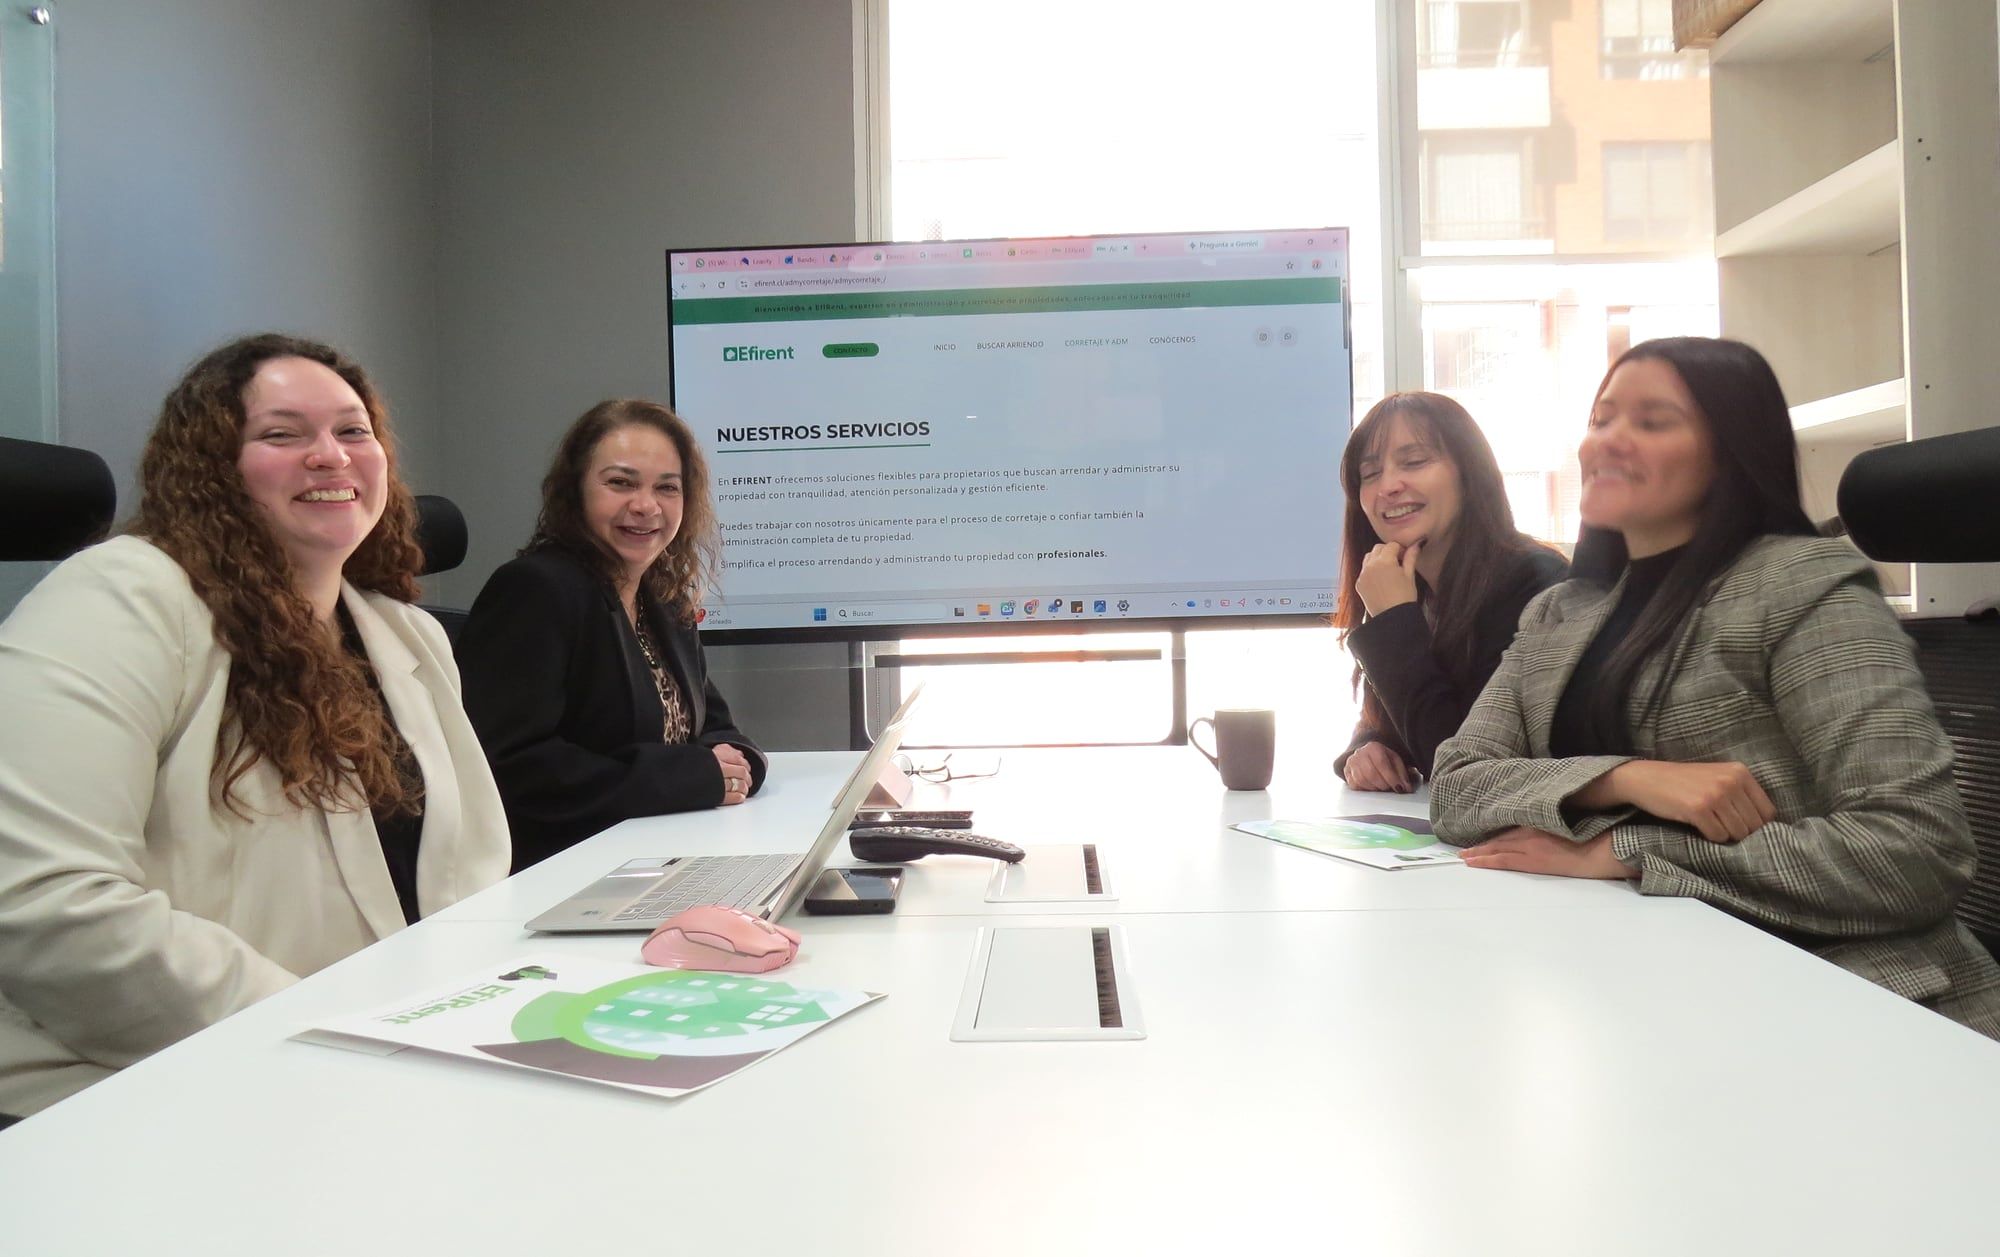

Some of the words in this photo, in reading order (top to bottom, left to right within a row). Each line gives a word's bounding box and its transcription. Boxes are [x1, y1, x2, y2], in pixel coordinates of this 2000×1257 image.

[933, 344, 956, 352] INICIO
[976, 342, 1006, 350] BUSCAR
[1006, 340, 1044, 349] ARRIENDO
[1064, 338, 1103, 348] CORRETAJE
[1111, 338, 1128, 346] ADM
[738, 346, 794, 362] Efirent
[717, 424, 822, 442] NUESTROS
[827, 421, 930, 438] SERVICIOS
[718, 477, 730, 486] En
[732, 476, 772, 486] EFIRENT
[774, 474, 824, 485] ofrecemos
[826, 472, 875, 483] soluciones
[878, 471, 916, 482] flexibles
[919, 472, 940, 482] para
[943, 469, 1000, 480] propietarios
[1003, 470, 1021, 479] que
[1024, 468, 1057, 478] buscan
[1059, 466, 1101, 476] arrendar
[1111, 464, 1166, 474] administrar
[1168, 465, 1180, 473] su
[718, 491, 766, 502] propiedad
[768, 492, 786, 500] con
[788, 488, 848, 500] tranquilidad,
[850, 486, 890, 497] atención
[893, 486, 958, 497] personalizada
[968, 484, 1003, 496] gestión
[1005, 482, 1048, 492] eficiente.
[720, 522, 753, 532] Puedes
[755, 520, 793, 532] trabajar
[795, 520, 812, 529] con
[814, 520, 856, 529] nosotros
[858, 517, 914, 528] únicamente
[916, 518, 938, 528] para
[940, 516, 948, 525] el
[951, 515, 988, 526] proceso
[990, 514, 1002, 522] de
[1005, 512, 1047, 524] corretaje
[1058, 512, 1092, 521] confiar
[1094, 510, 1133, 520] también
[1136, 510, 1144, 518] la
[720, 536, 789, 547] administración
[791, 535, 834, 546] completa
[837, 534, 849, 543] de
[851, 534, 861, 542] tu
[863, 532, 914, 544] propiedad.
[721, 558, 765, 570] Simplifica
[768, 558, 776, 568] el
[778, 559, 816, 570] proceso
[818, 556, 872, 566] arrendando
[883, 554, 952, 564] administrando
[954, 554, 964, 562] tu
[966, 552, 1015, 563] propiedad
[1018, 552, 1034, 560] con
[1037, 549, 1108, 561] profesionales.
[852, 610, 874, 618] Buscar
